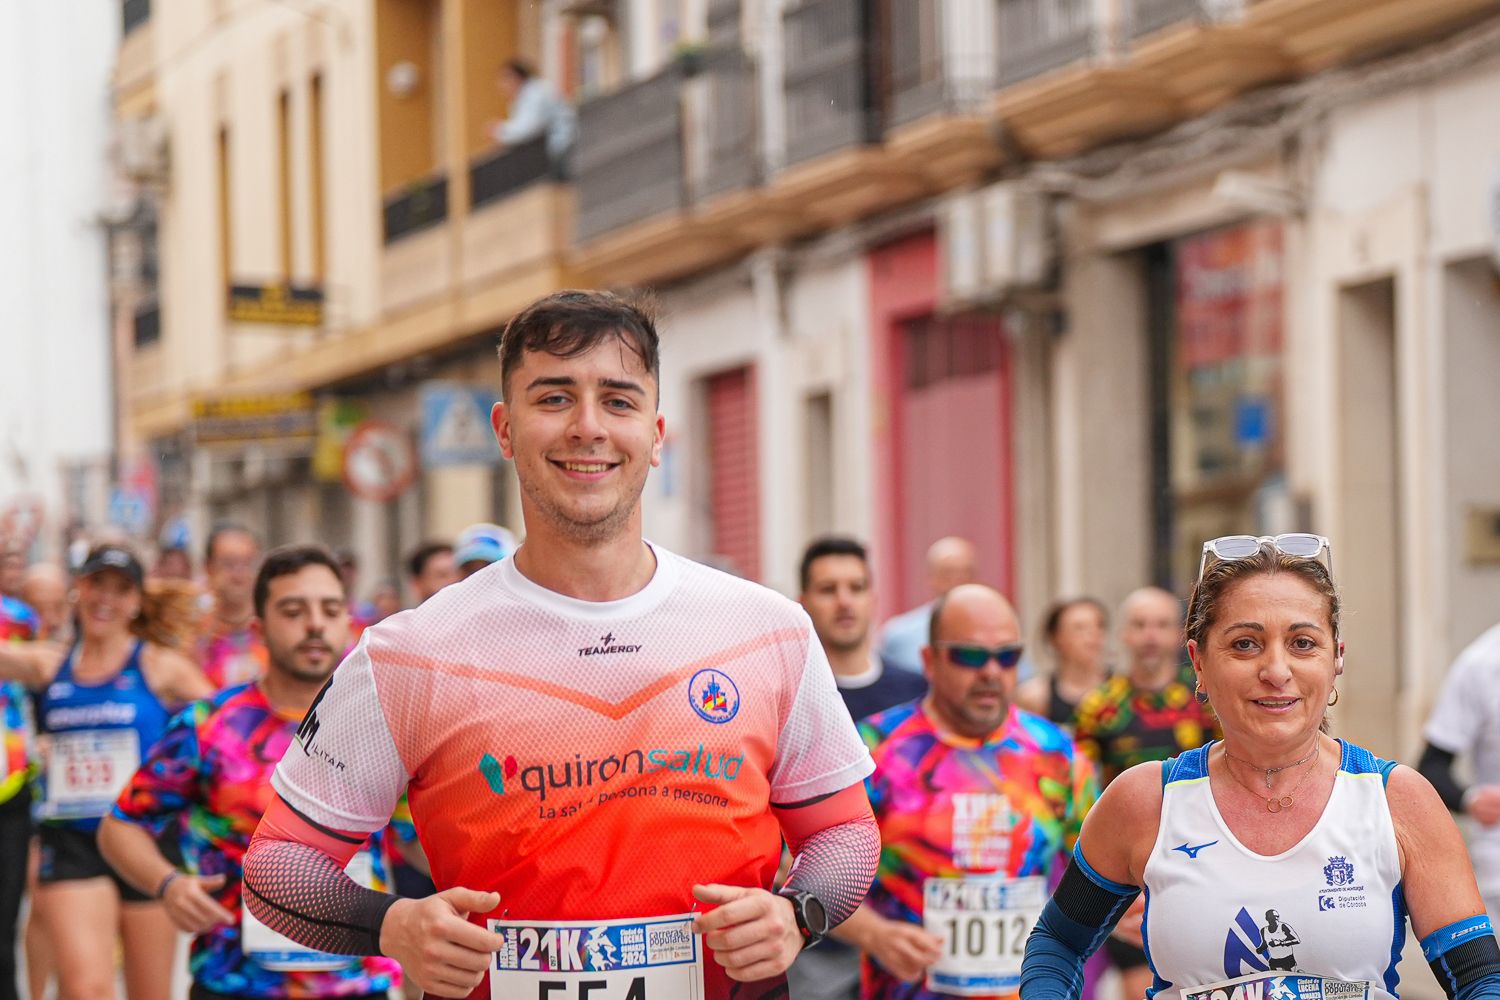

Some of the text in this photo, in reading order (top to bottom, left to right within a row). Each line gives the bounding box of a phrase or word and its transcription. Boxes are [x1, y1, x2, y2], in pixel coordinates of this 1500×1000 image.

[577, 644, 642, 657] TEAMERGY
[539, 805, 556, 819] La
[673, 787, 729, 808] persona
[649, 934, 690, 948] populares
[945, 916, 1027, 957] 1012
[520, 928, 583, 970] 21K
[621, 951, 646, 966] 2026
